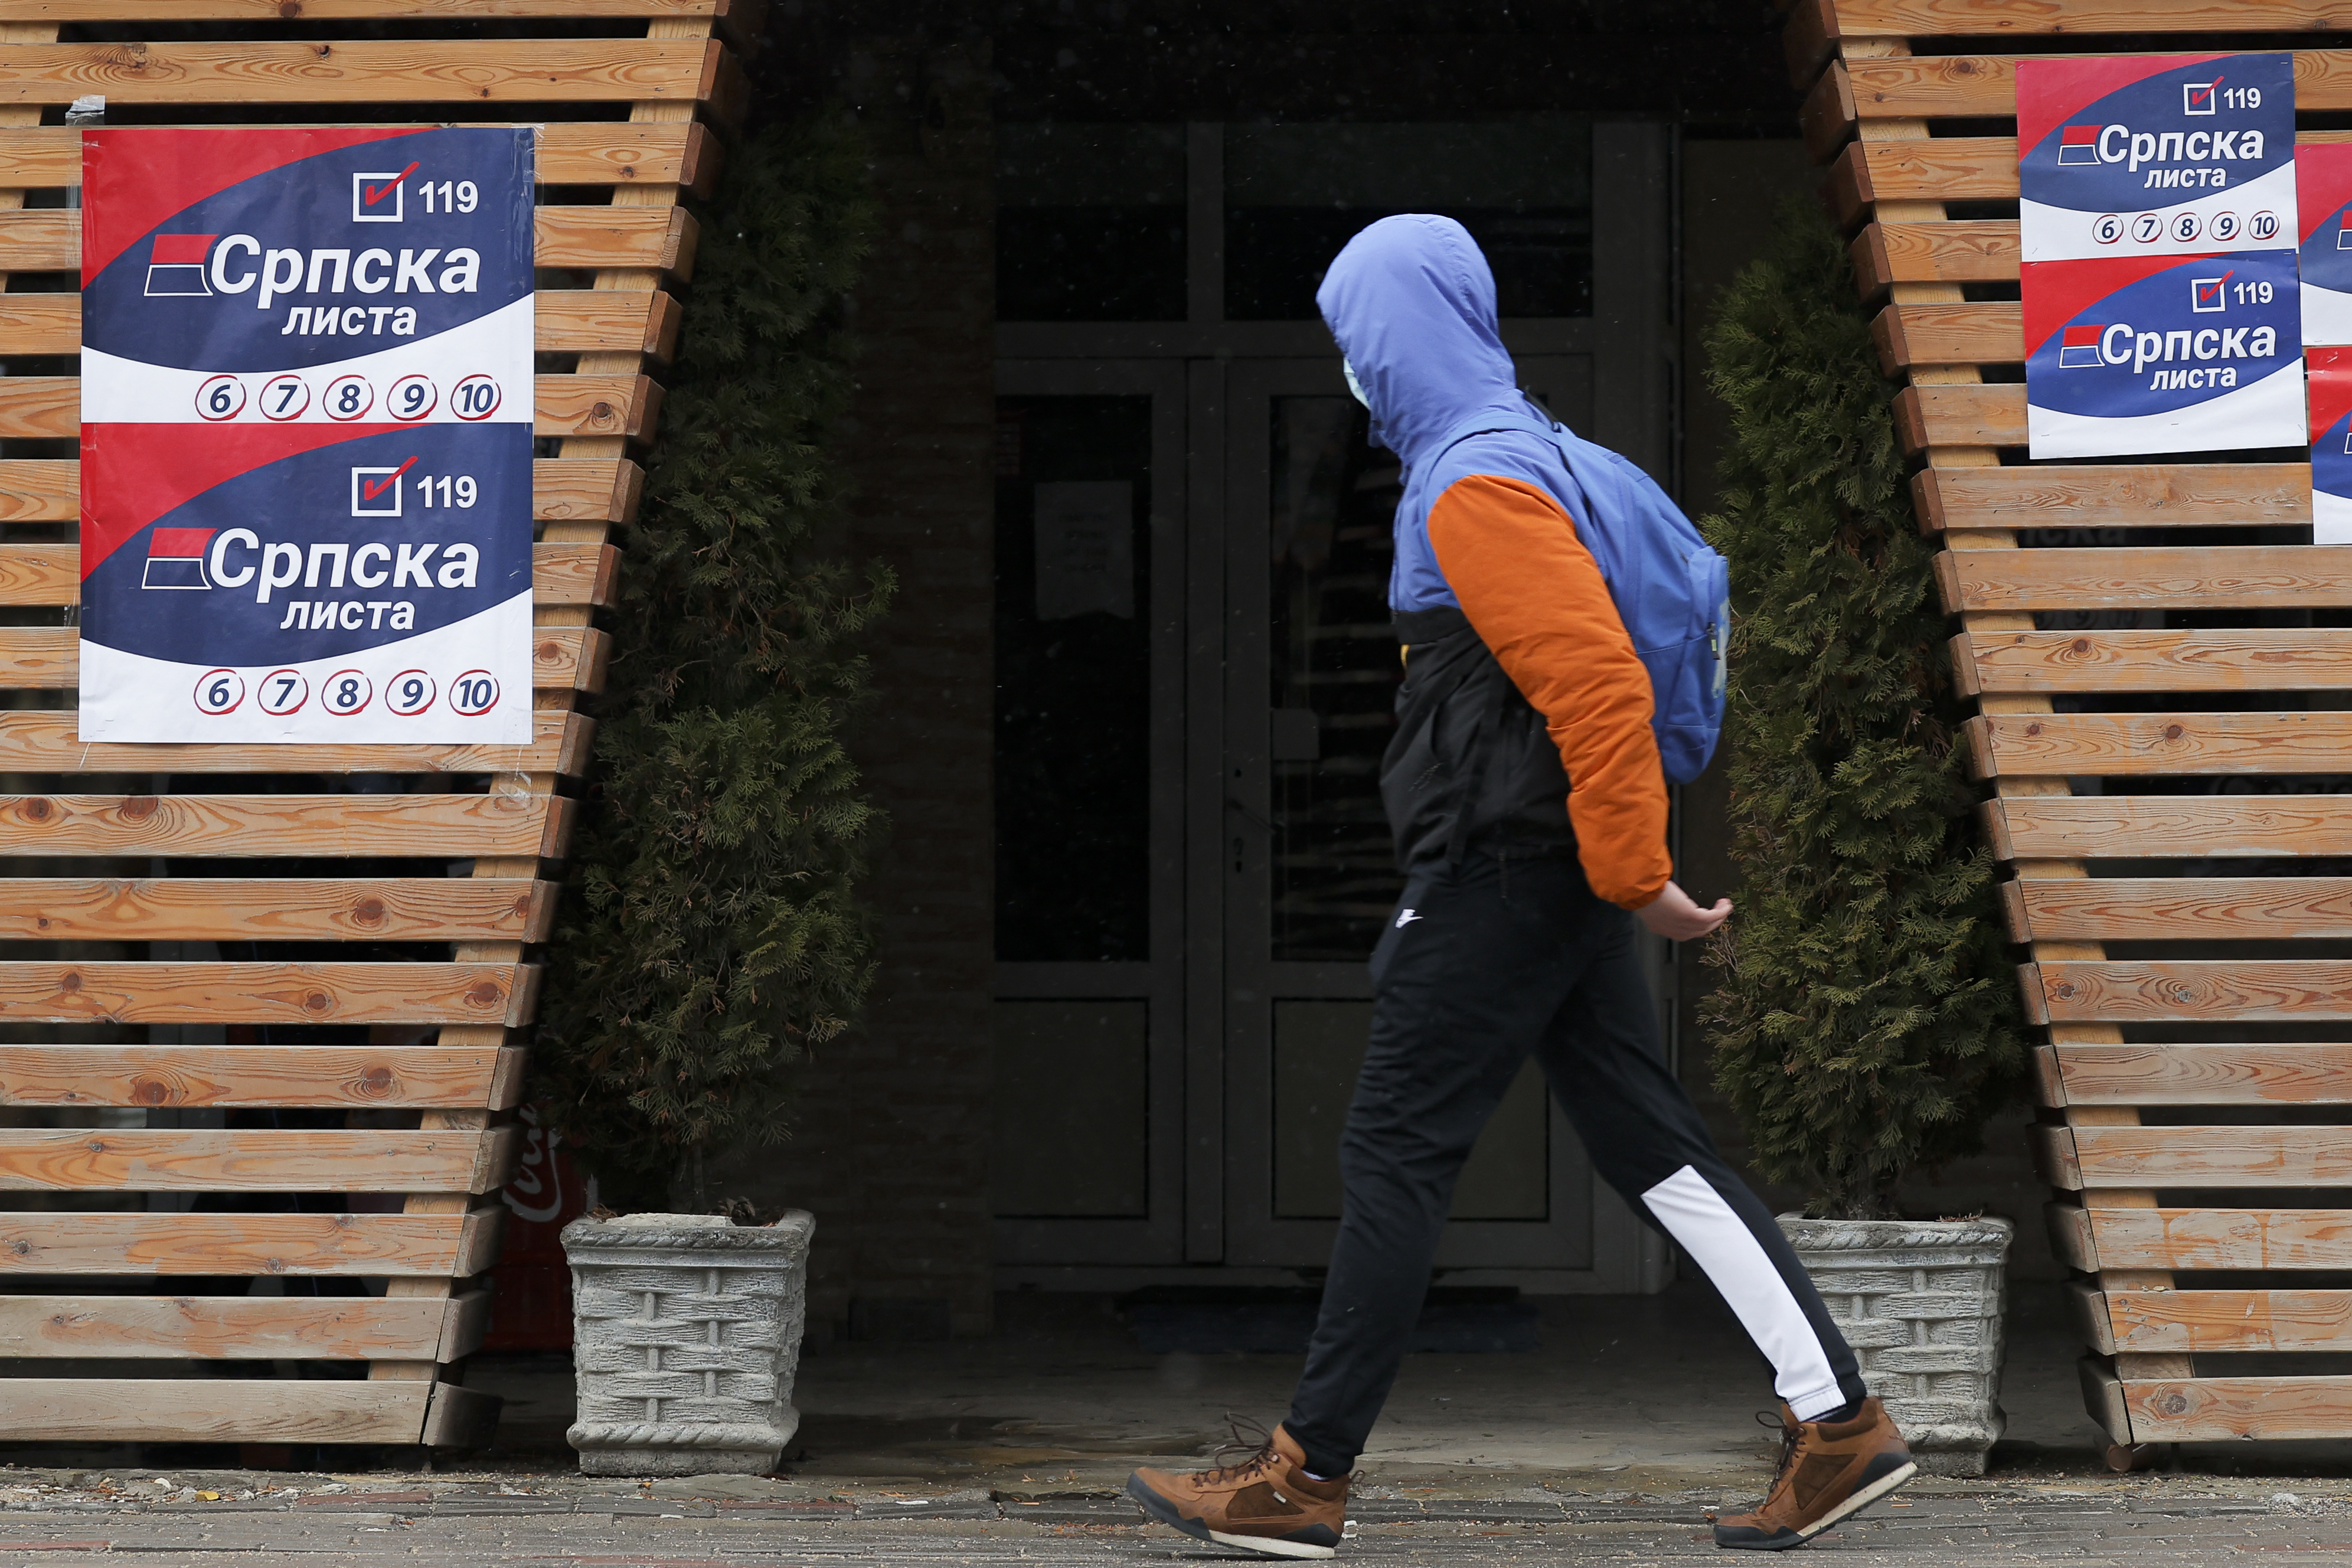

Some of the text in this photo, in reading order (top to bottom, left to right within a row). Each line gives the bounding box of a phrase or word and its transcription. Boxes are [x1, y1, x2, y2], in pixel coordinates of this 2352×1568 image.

[2223, 87, 2262, 109] 119
[2098, 123, 2265, 173] Српска
[2143, 168, 2227, 189] листа
[418, 180, 479, 214] 119
[2101, 216, 2274, 238] 6 7 8 9 10
[210, 234, 481, 309] Српска
[2233, 280, 2273, 305] 119
[281, 306, 417, 336] листа
[2102, 323, 2277, 374] Српска
[2149, 367, 2237, 391] листа
[210, 384, 494, 413] 6 7 8 9 10
[417, 475, 478, 509] 119
[209, 527, 480, 604] Српска
[280, 600, 416, 631] листа
[208, 678, 492, 707] 6 7 8 9 10
